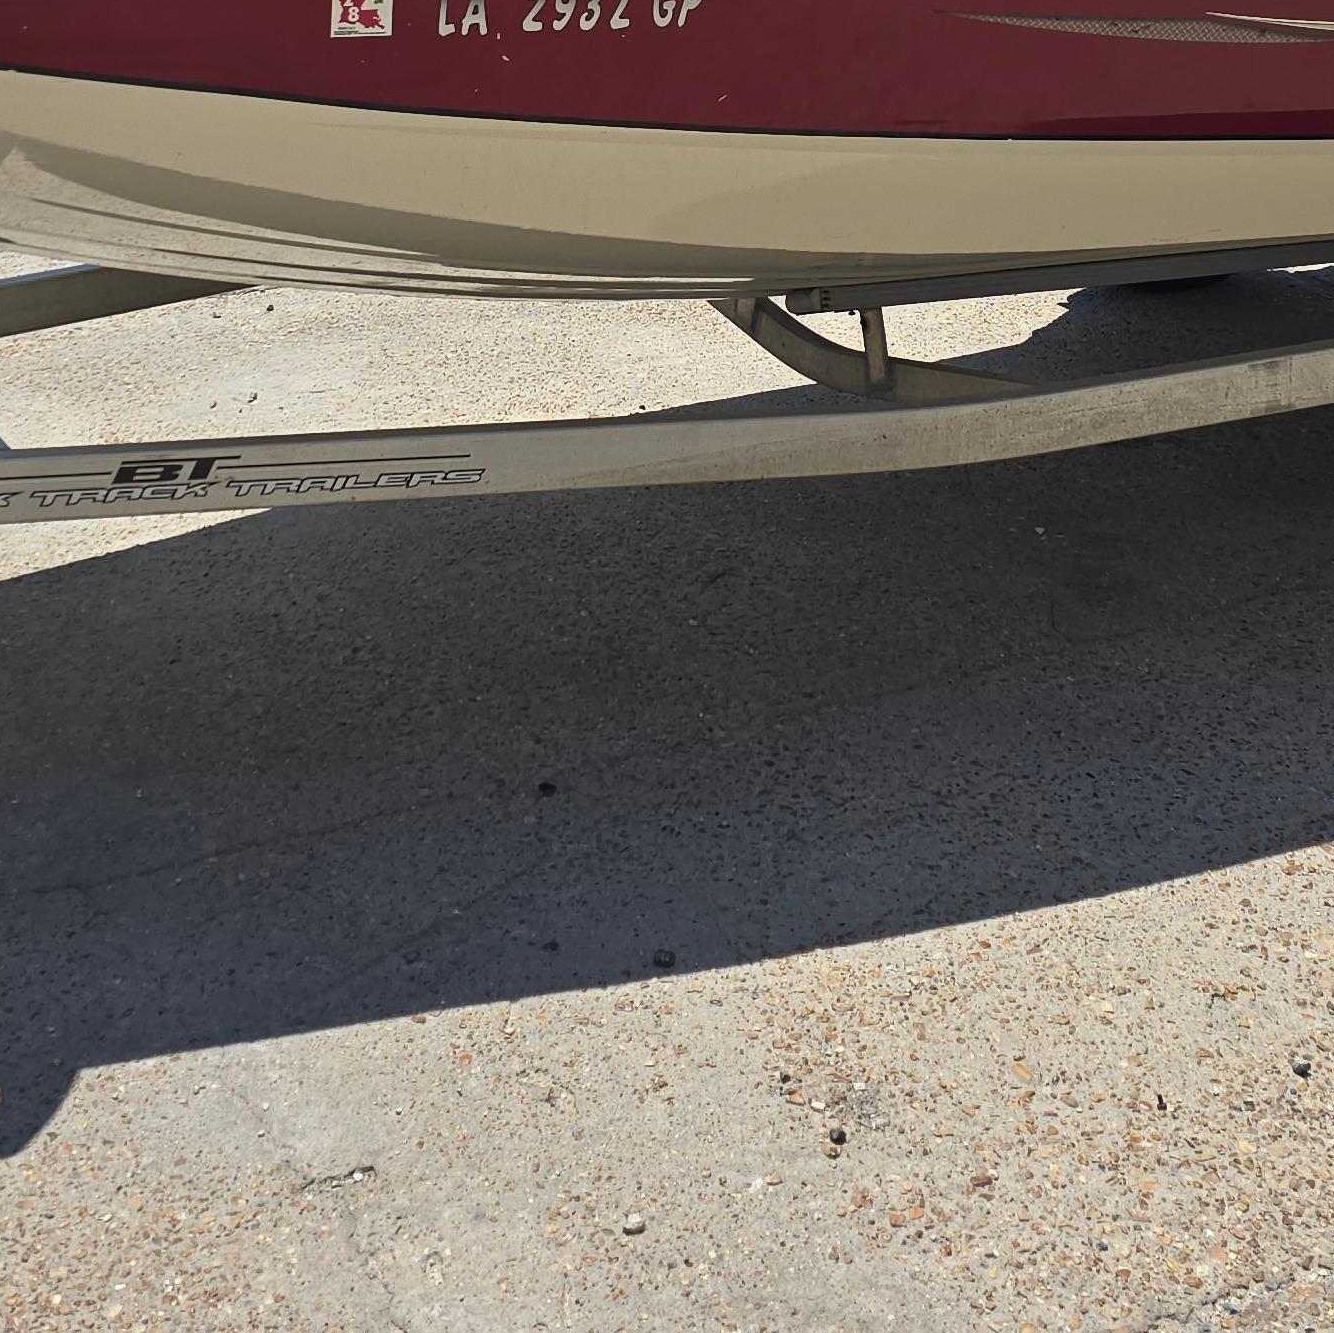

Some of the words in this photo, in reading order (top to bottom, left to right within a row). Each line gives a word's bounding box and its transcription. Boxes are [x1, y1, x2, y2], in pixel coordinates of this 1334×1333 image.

[348, 7, 359, 22] 8
[31, 482, 217, 508] TRACK
[227, 469, 486, 498] TRAILERS
